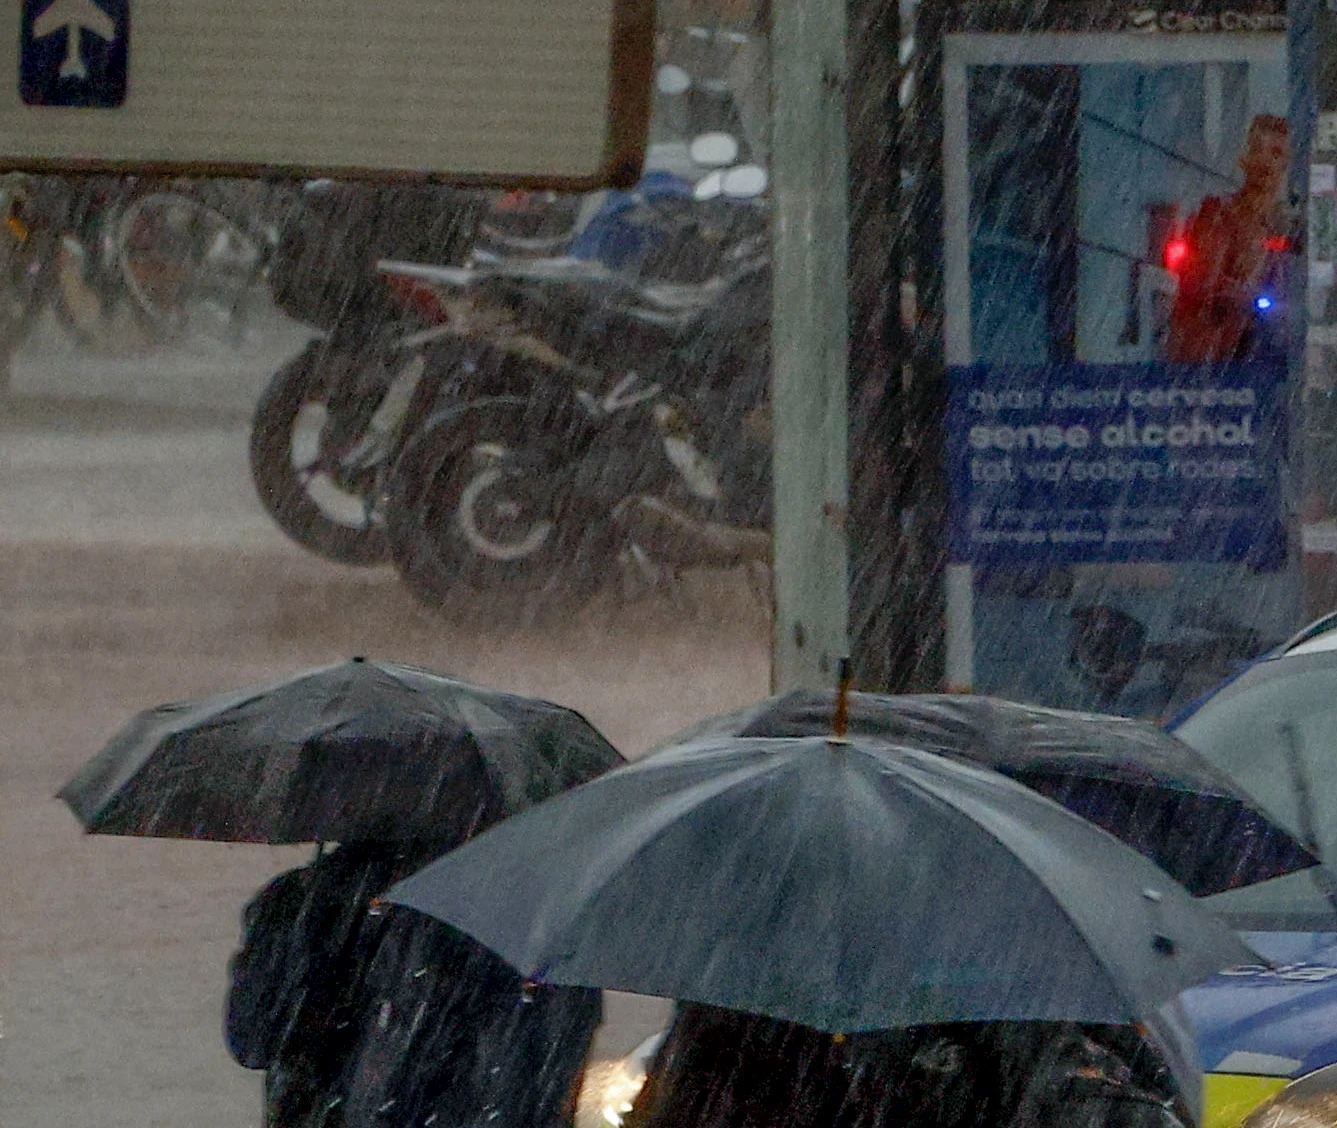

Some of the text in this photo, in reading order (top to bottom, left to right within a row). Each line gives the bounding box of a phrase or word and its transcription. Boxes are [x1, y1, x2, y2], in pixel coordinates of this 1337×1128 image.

[968, 411, 1254, 449] sense alcohol
[971, 457, 1015, 482] tot
[1070, 456, 1161, 482] sobre
